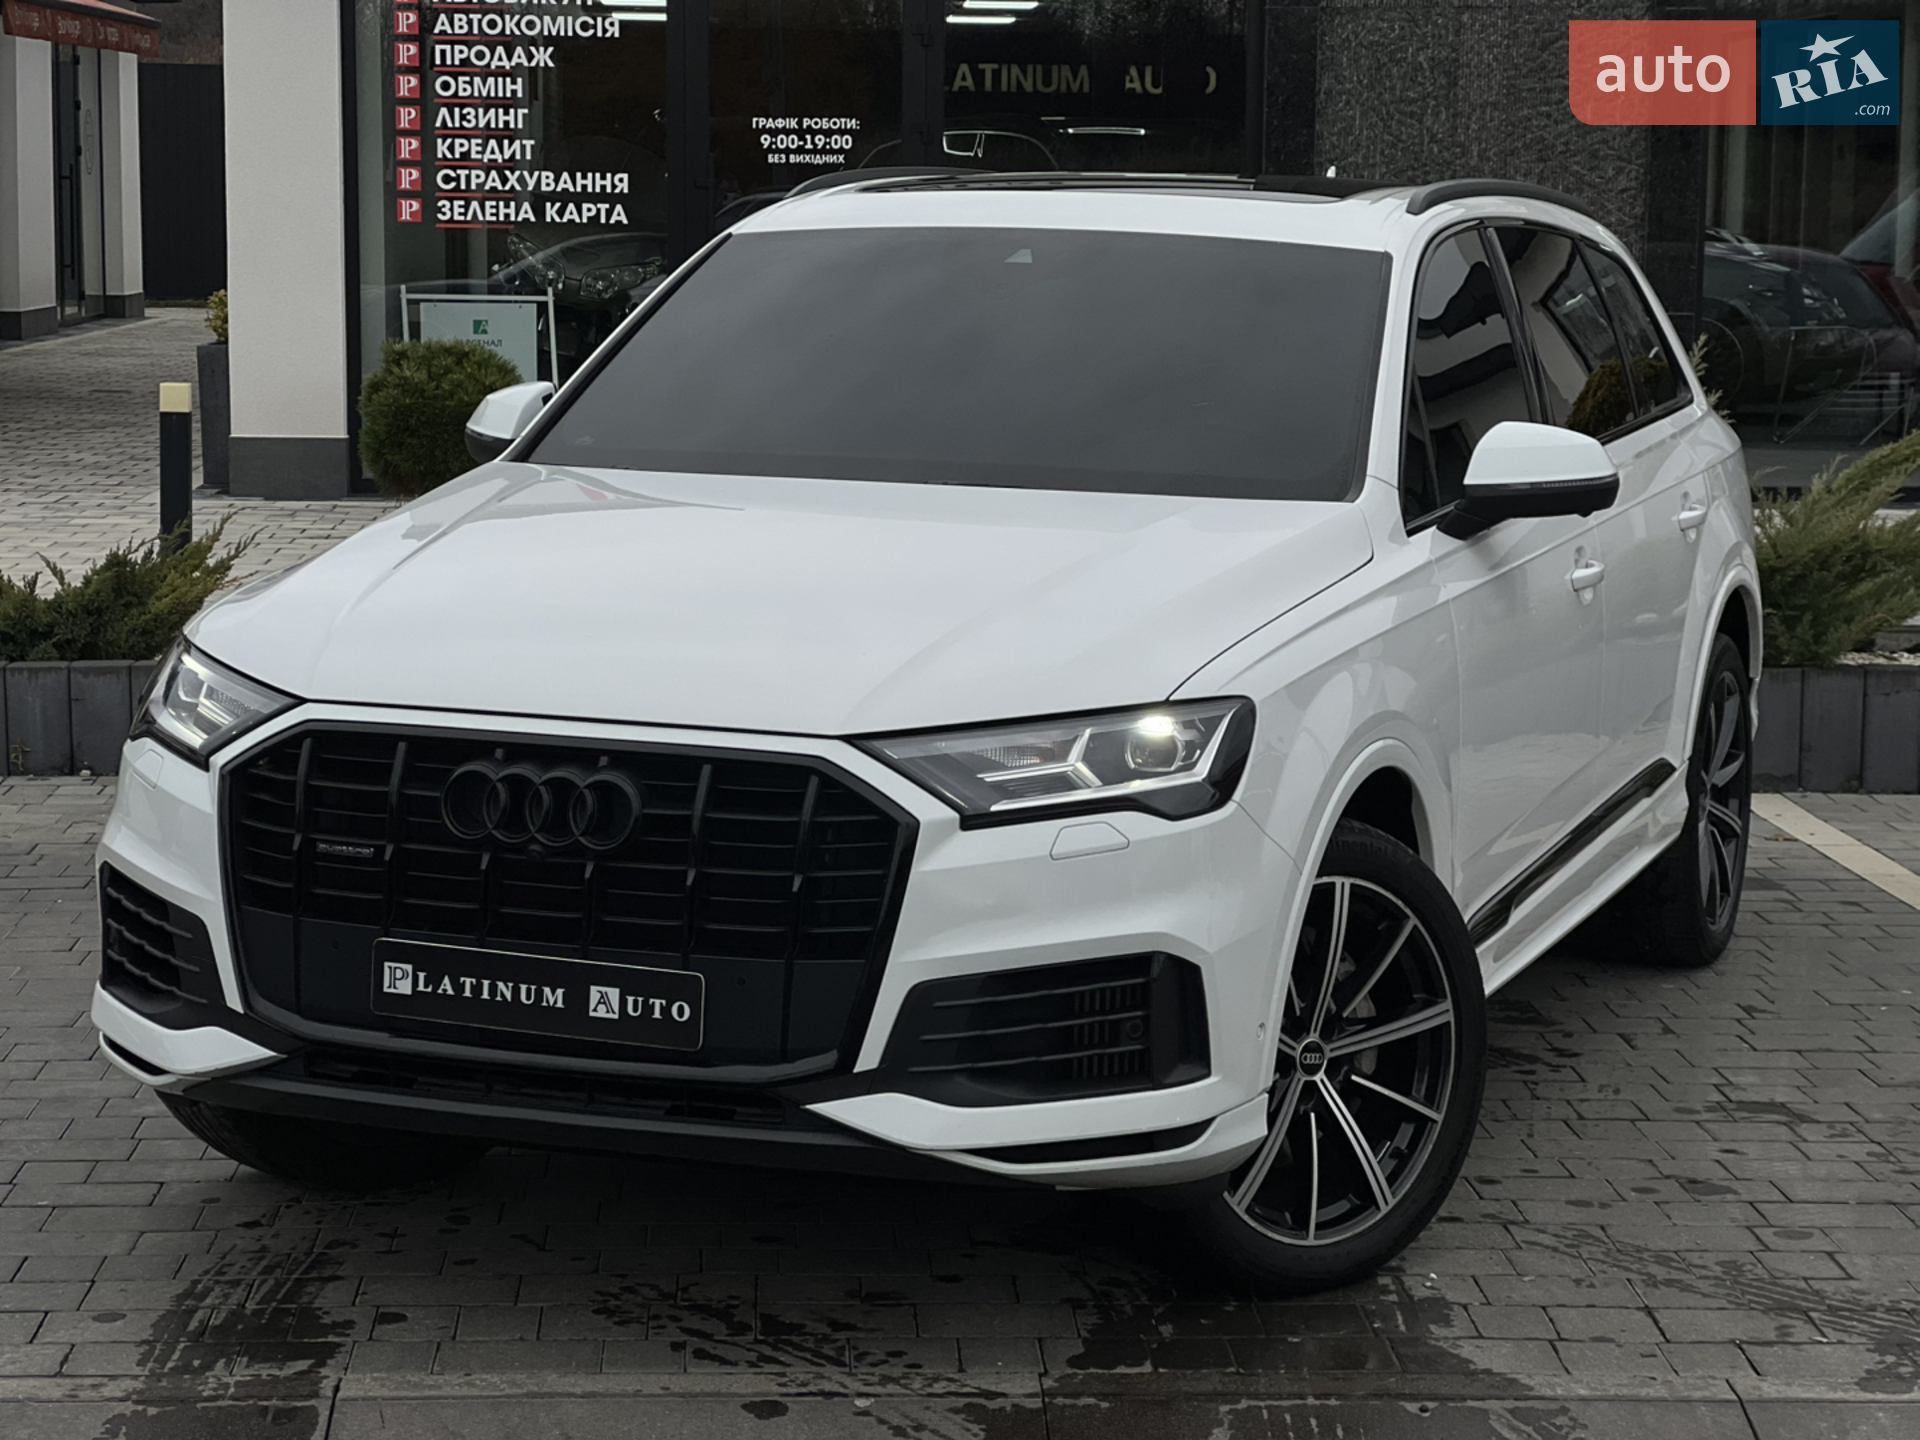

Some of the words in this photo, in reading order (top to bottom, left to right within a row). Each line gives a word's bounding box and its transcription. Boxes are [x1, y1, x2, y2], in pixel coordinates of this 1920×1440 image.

[434, 13, 619, 37] АВТОКОМІСІЯ
[435, 45, 554, 69] ПРОДАЖ
[435, 76, 522, 97] ОБМІН
[947, 63, 1091, 94] ATINUM
[435, 107, 528, 128] ЛІЗИНГ
[753, 118, 798, 128] ГРАФІК
[803, 118, 860, 129] РОБОТИ:
[437, 138, 535, 163] КРЕДИТ
[760, 134, 852, 149] 9:00-19:00
[768, 154, 786, 163] БЕЗ
[789, 154, 844, 164] ВИХІДНИХ
[437, 169, 628, 193] СТРАХУВАННЯ
[437, 200, 535, 221] ЗЕЛЕНА
[546, 202, 628, 224] КАРТА
